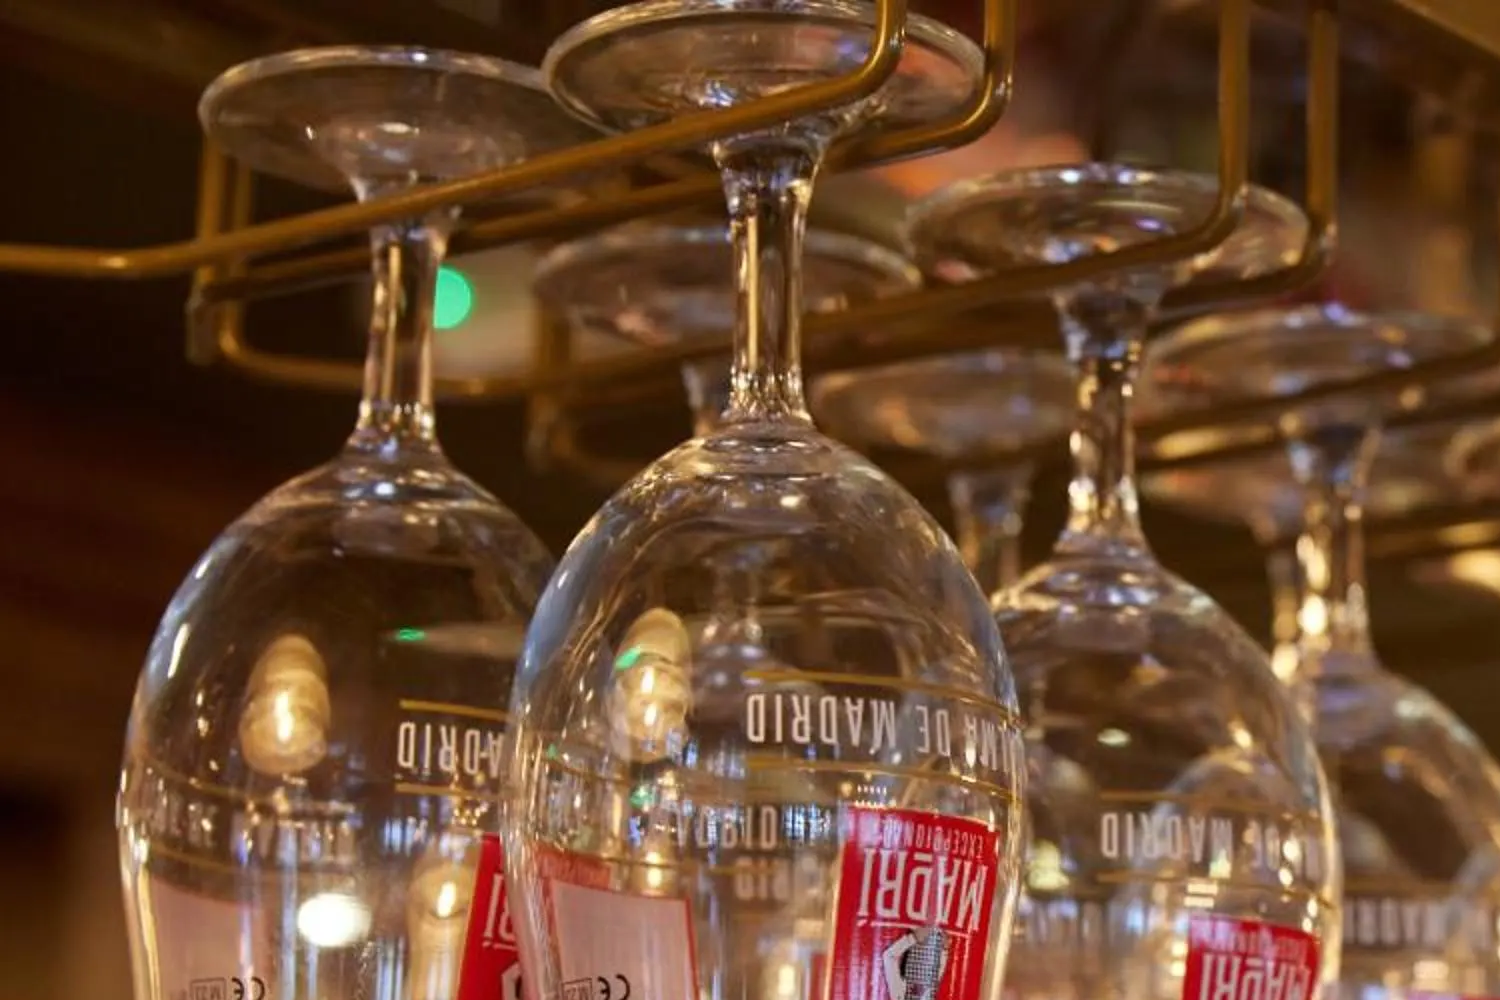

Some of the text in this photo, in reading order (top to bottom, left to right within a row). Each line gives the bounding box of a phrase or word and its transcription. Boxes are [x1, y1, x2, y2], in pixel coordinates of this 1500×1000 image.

[397, 720, 506, 779] ADRID
[745, 693, 897, 751] MADRID
[914, 704, 951, 758] DE
[1099, 810, 1234, 863] MADRID
